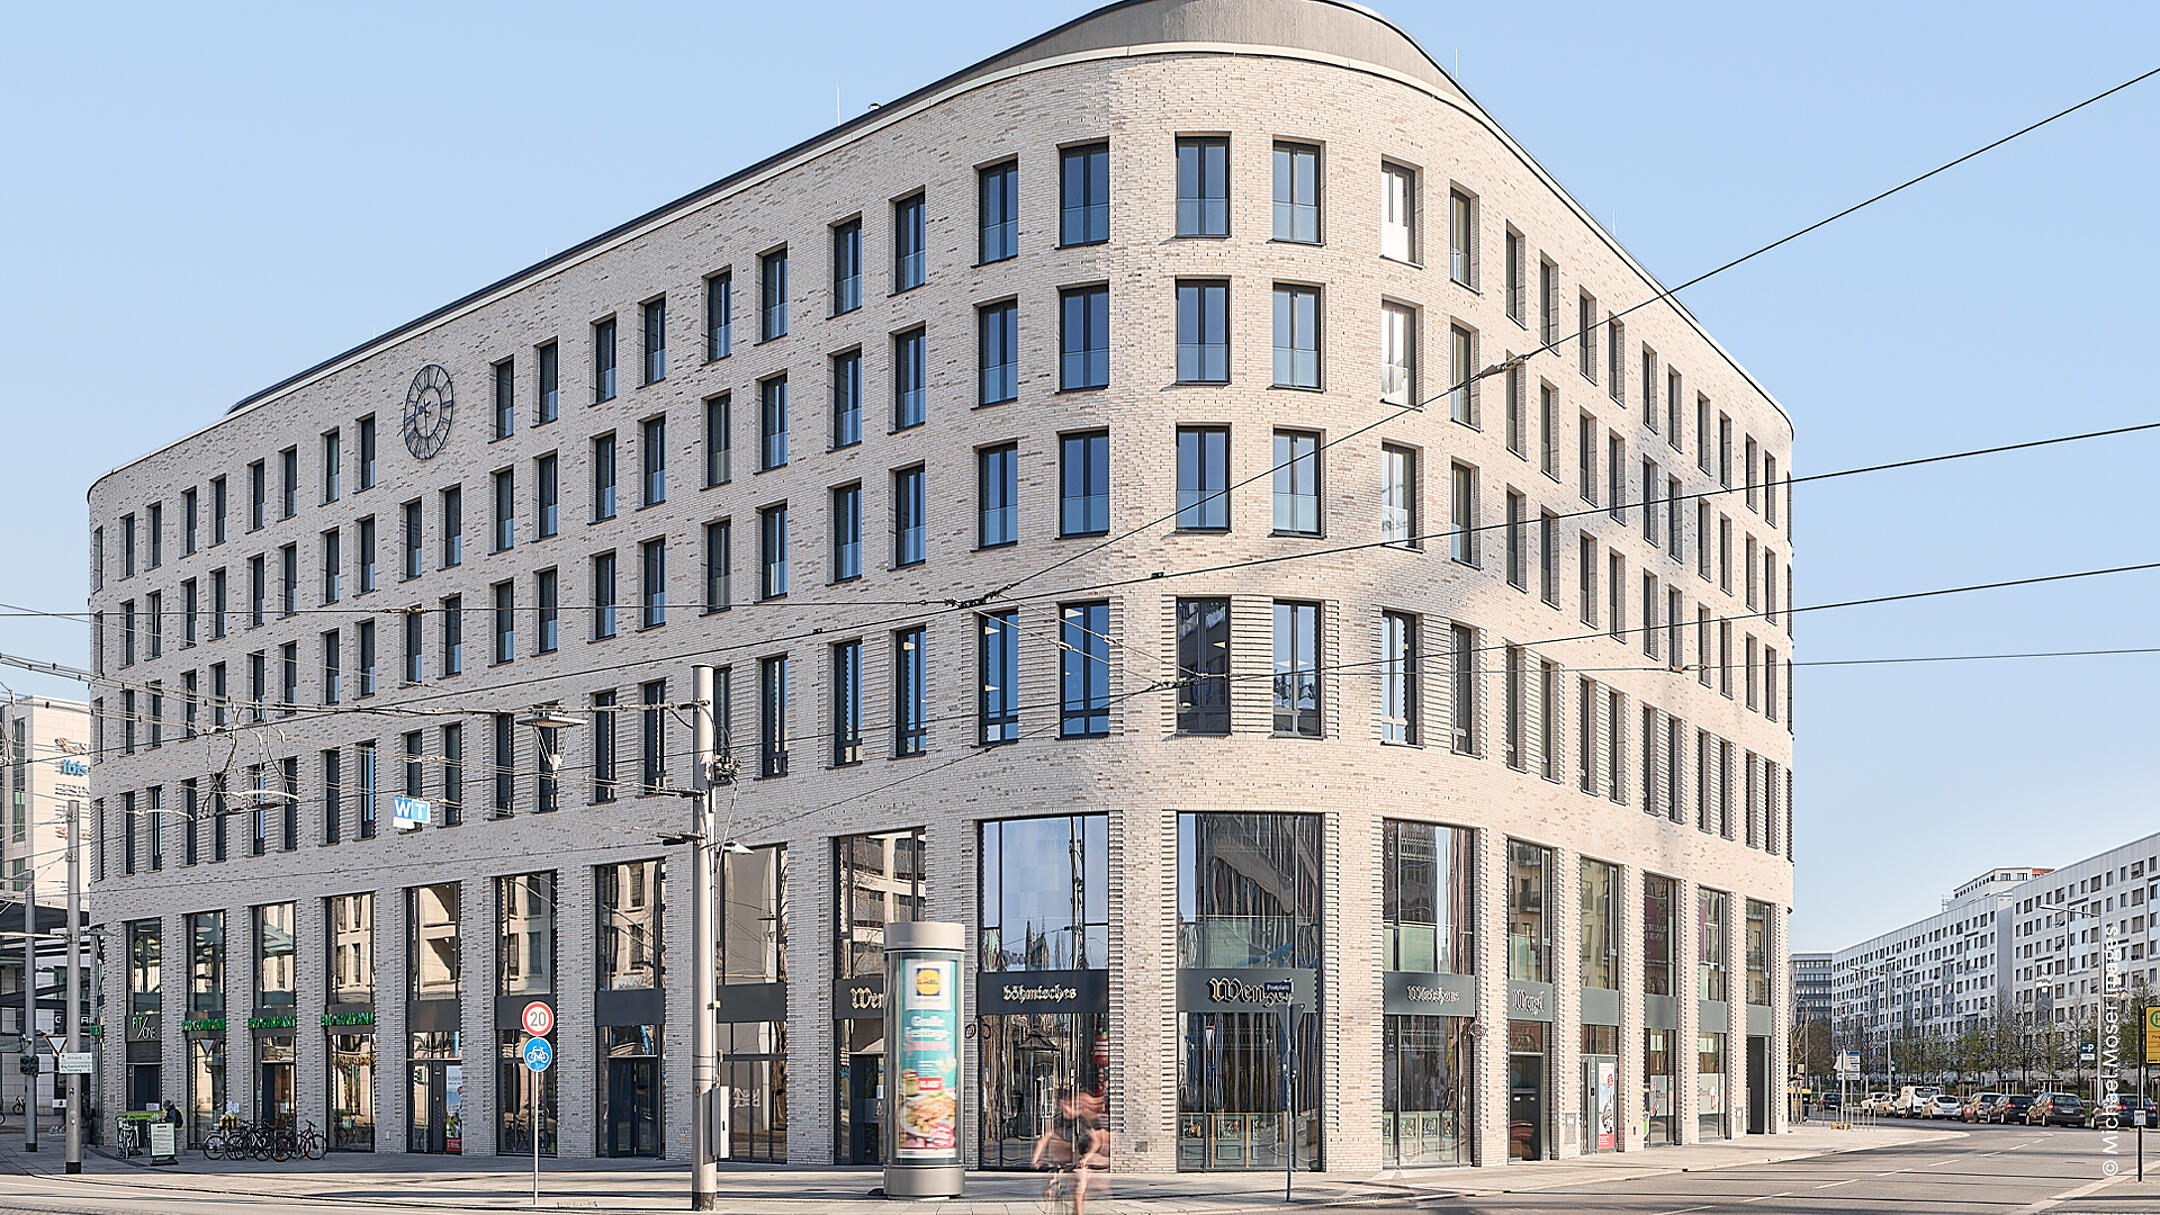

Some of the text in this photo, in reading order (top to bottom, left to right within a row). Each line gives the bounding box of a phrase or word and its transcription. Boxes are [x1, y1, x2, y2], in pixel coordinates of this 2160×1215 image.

[62, 759, 88, 776] ibis
[1003, 984, 1078, 1002] böhmisches
[530, 1011, 547, 1027] 20
